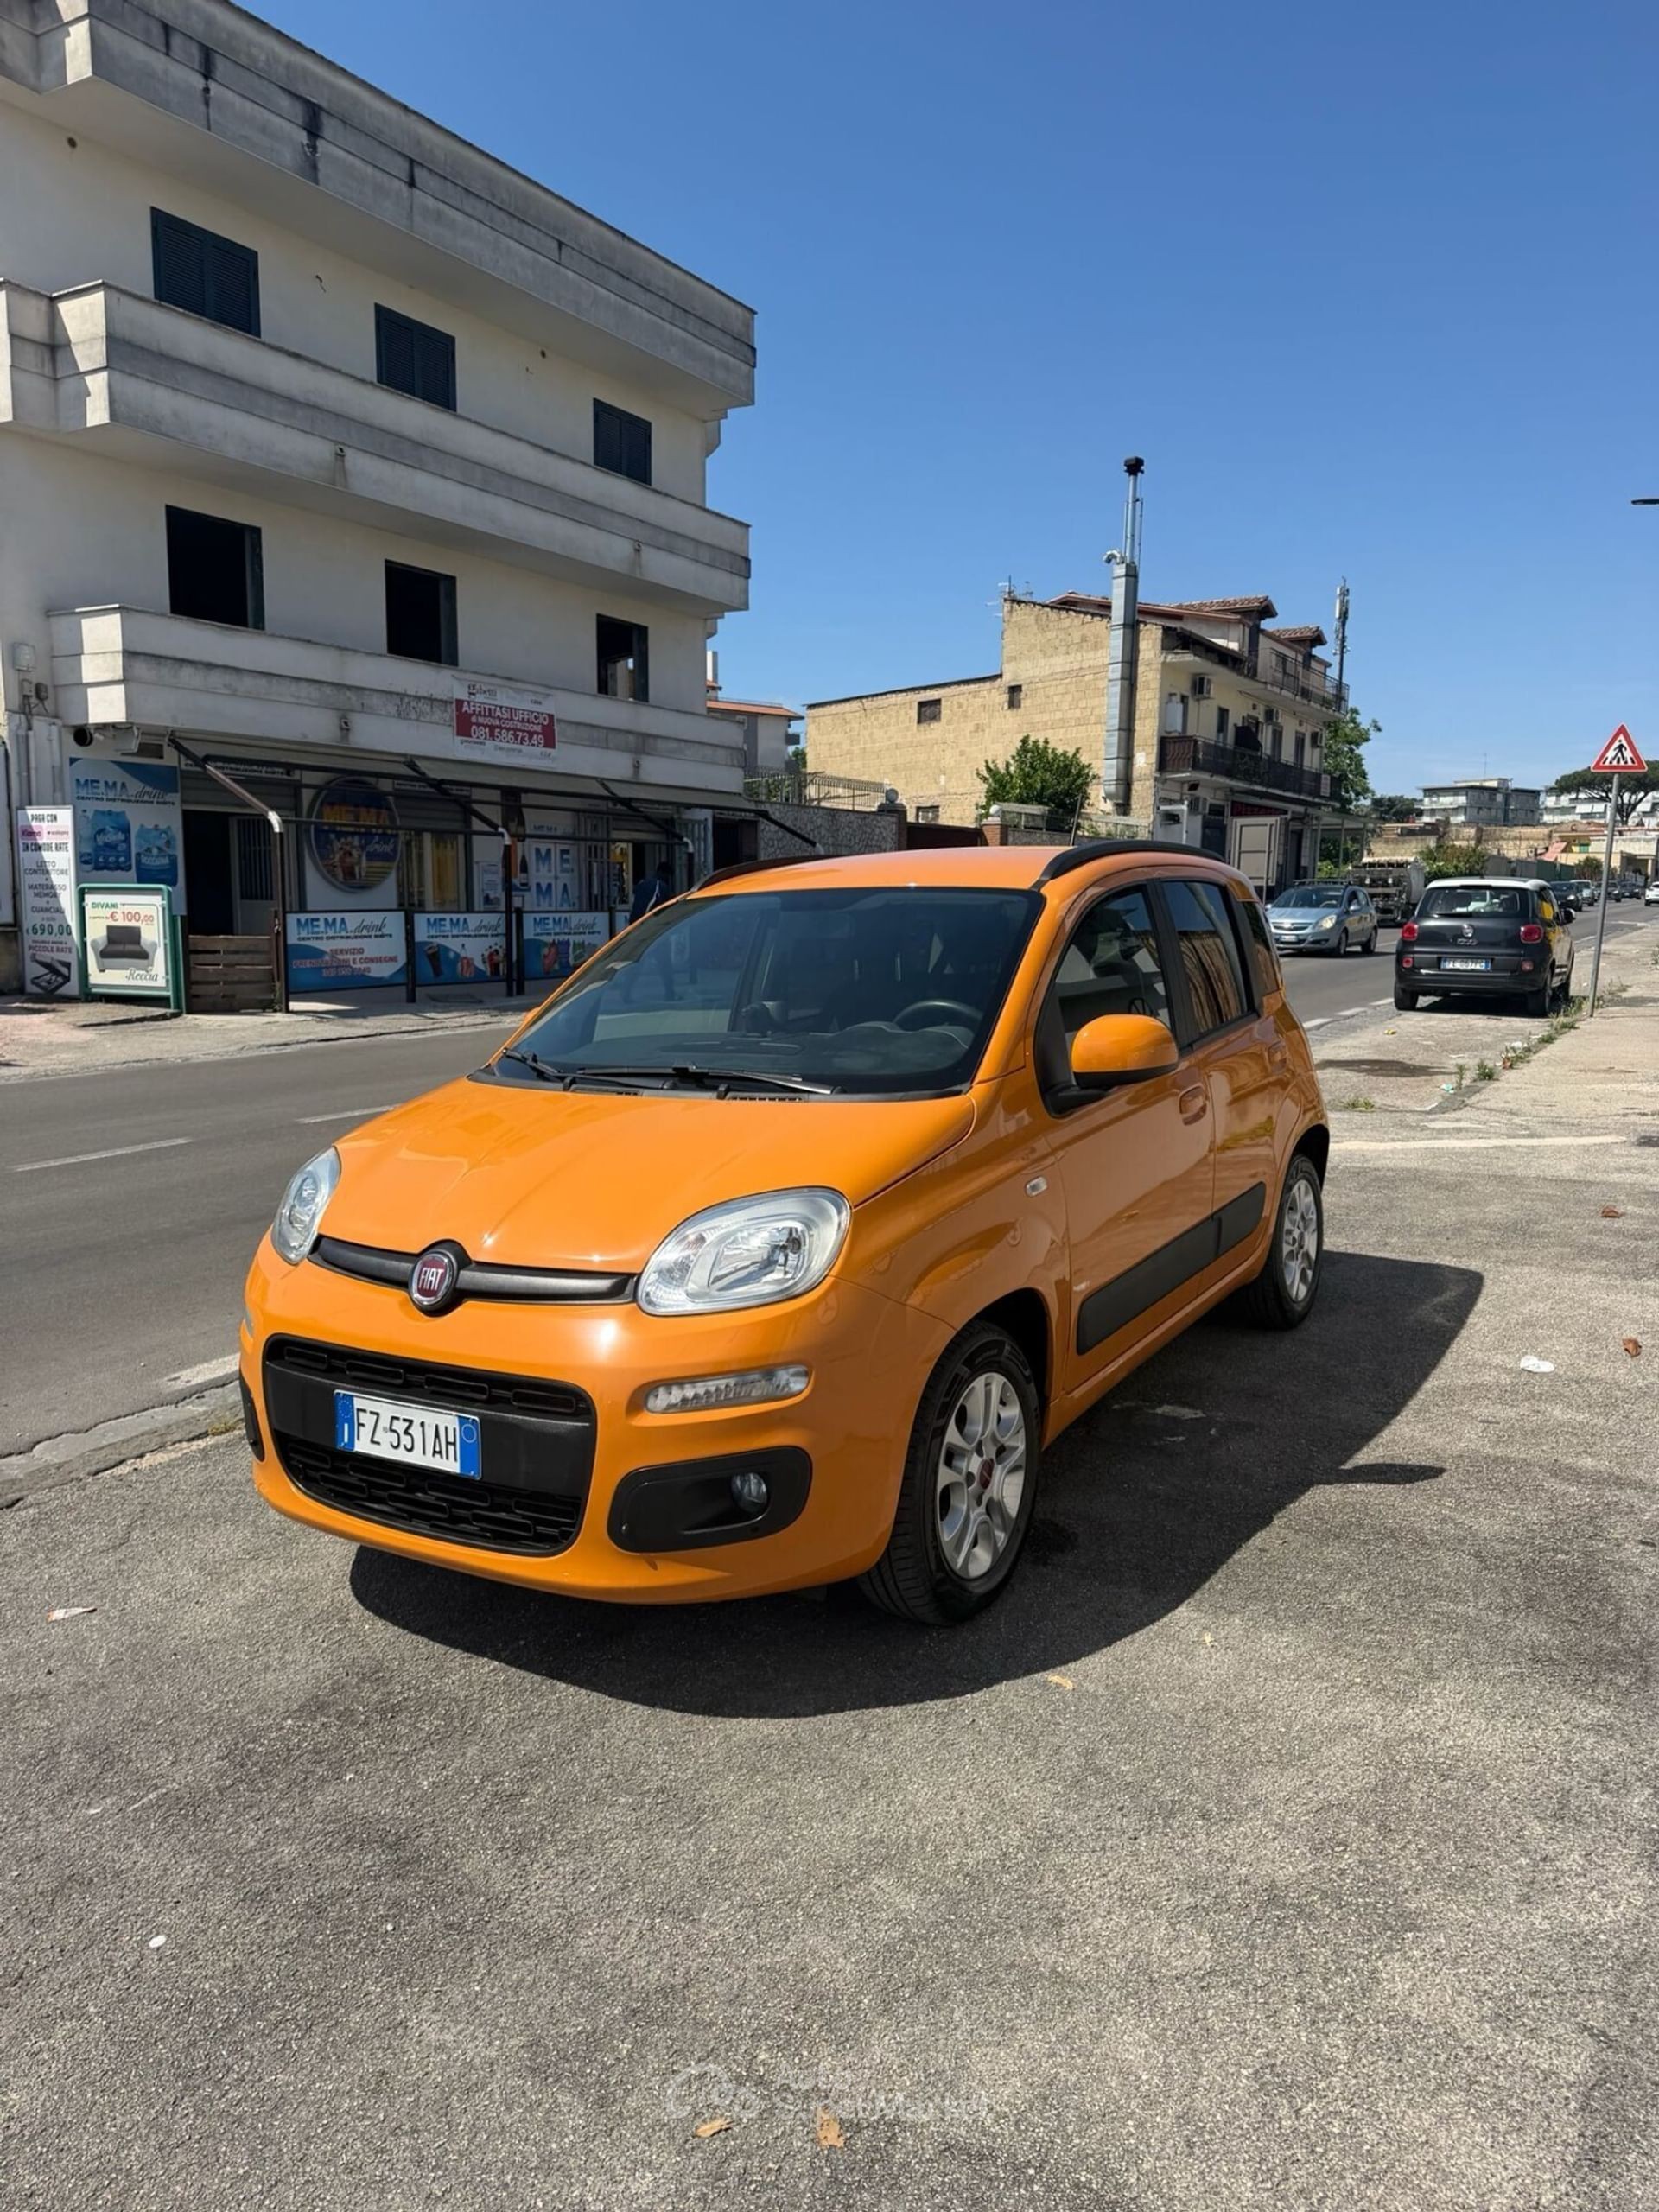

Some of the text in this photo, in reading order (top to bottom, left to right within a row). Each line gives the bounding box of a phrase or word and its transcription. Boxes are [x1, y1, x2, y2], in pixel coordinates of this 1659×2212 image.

[461, 701, 550, 726] AFFITTASI UFFICIO
[46, 813, 58, 823] CON
[110, 911, 118, 922] €
[31, 923, 73, 936] 690,00
[418, 1267, 445, 1291] FIAT
